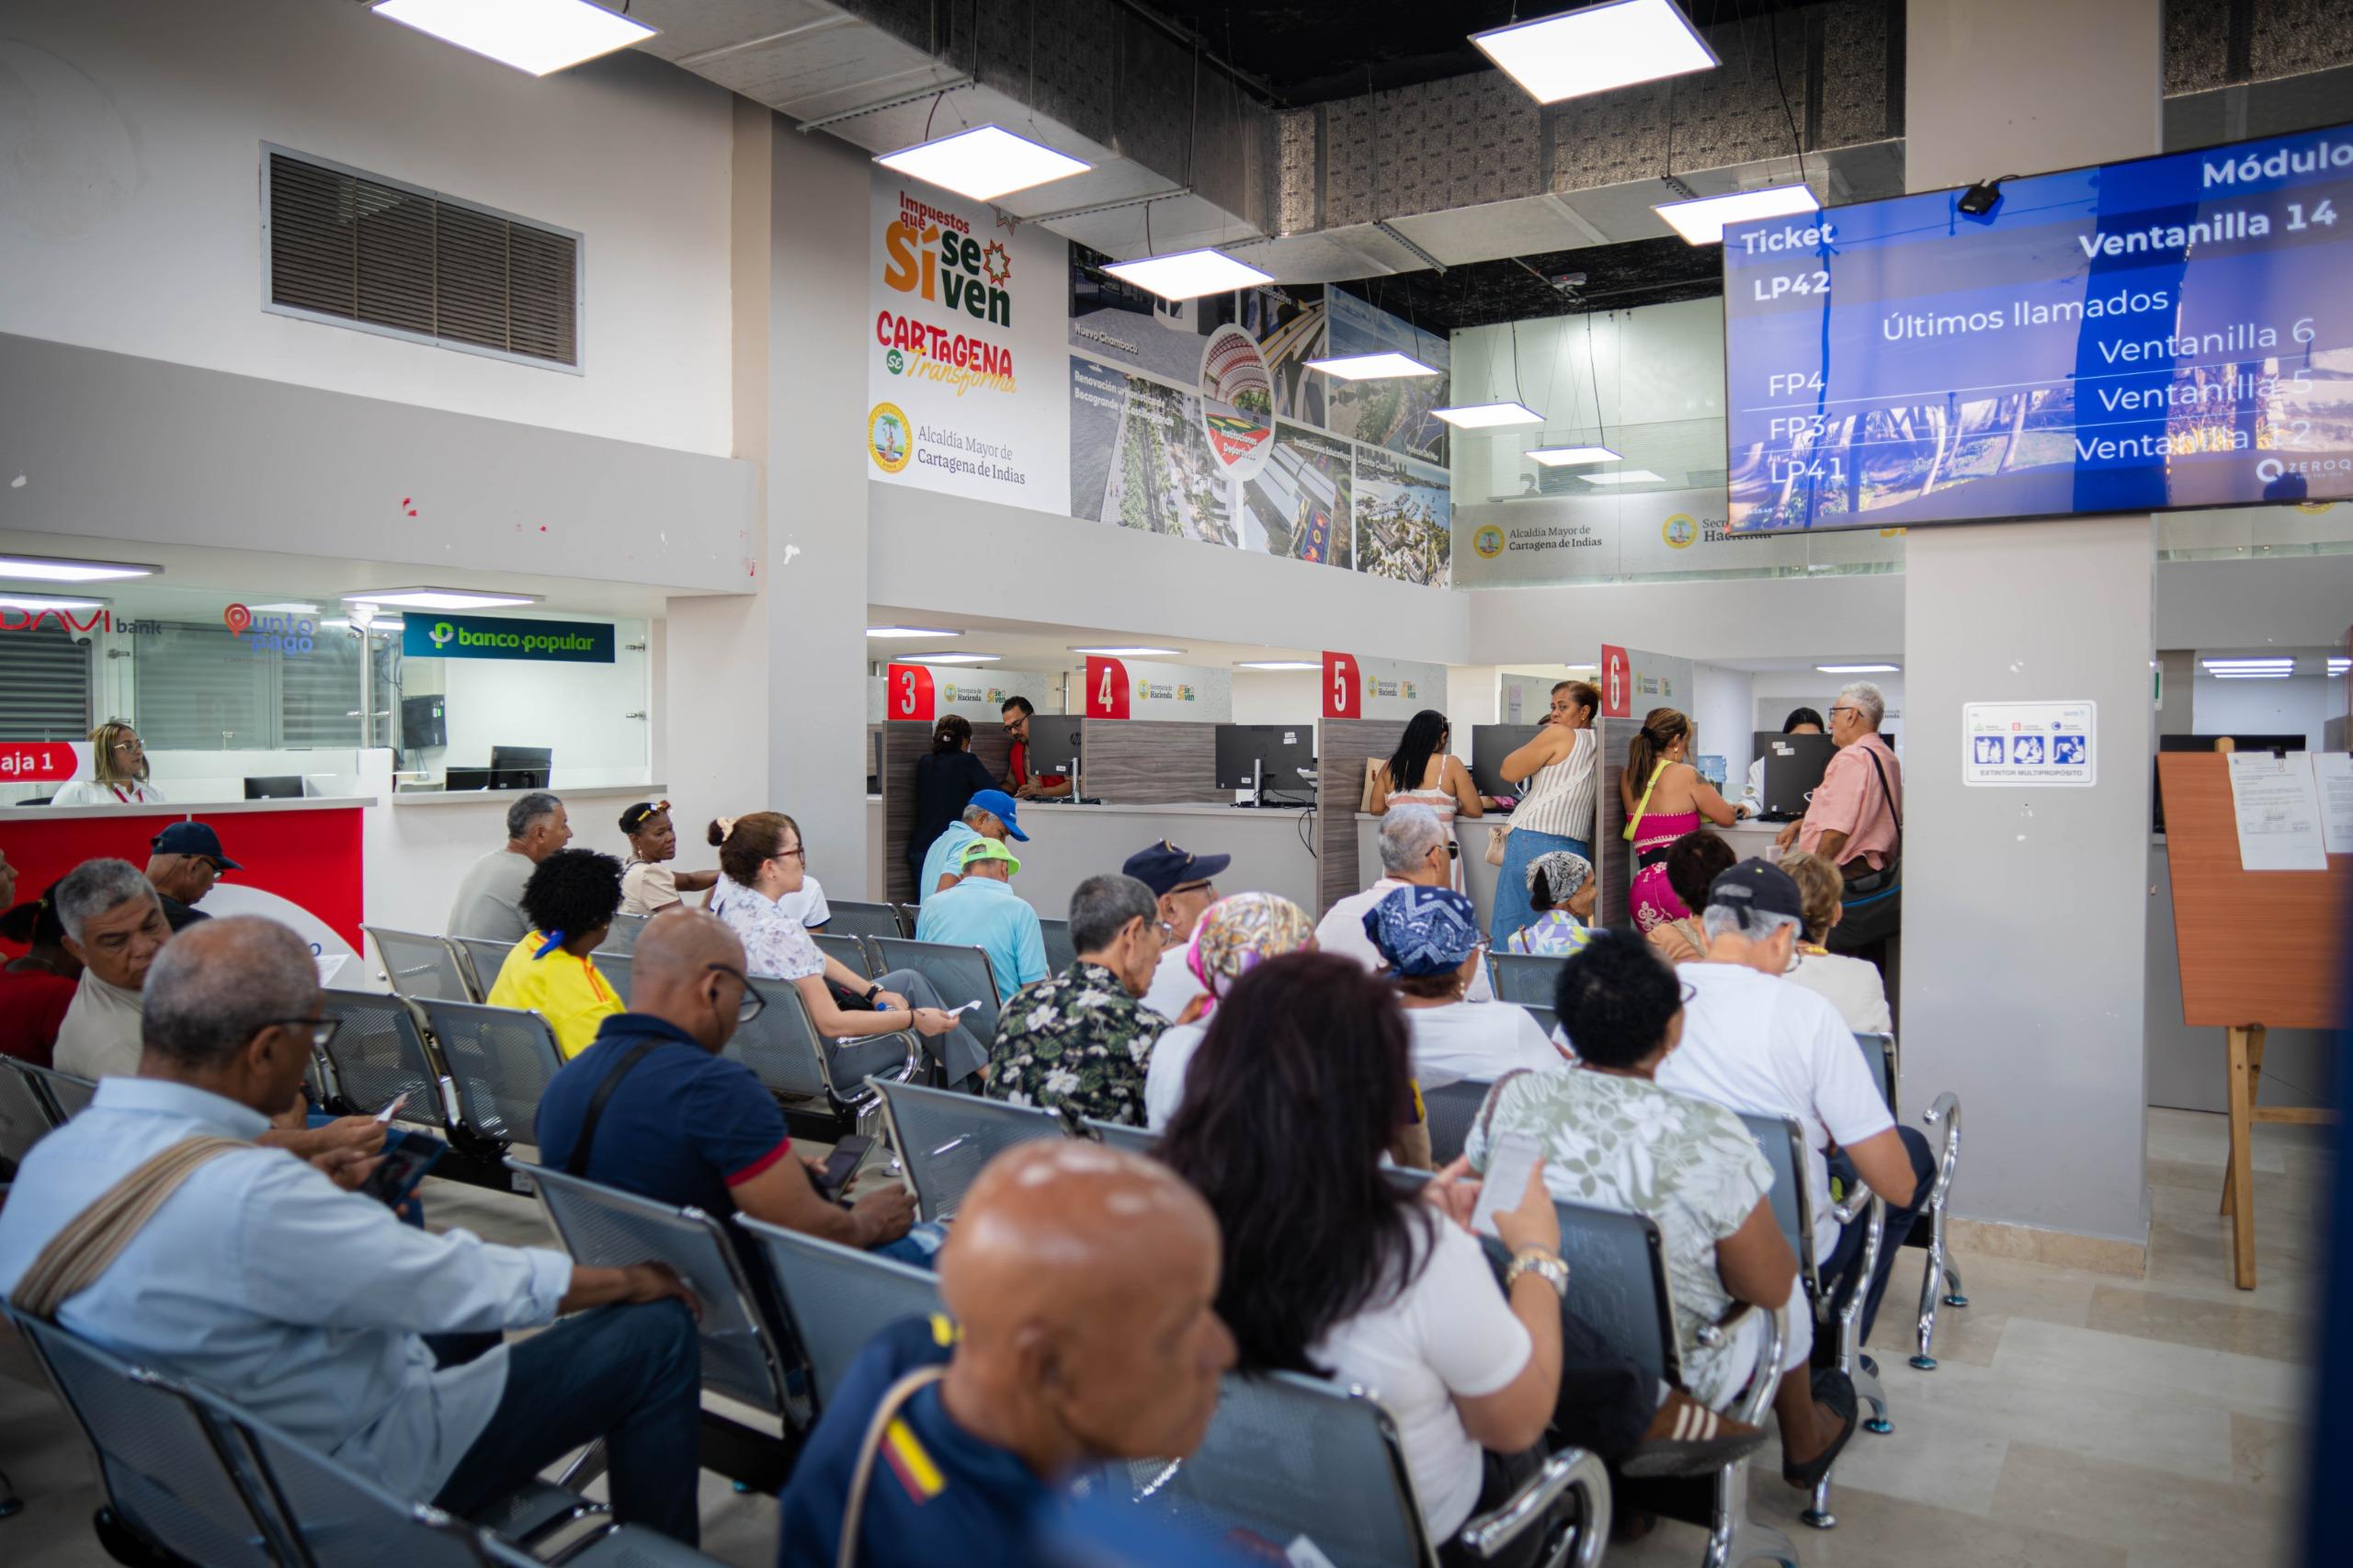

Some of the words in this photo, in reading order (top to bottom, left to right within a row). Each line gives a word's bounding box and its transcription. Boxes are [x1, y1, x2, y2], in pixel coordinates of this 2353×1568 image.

[2202, 142, 2353, 187] Módulo
[900, 190, 970, 234] Impuestos
[900, 210, 926, 231] que
[2078, 210, 2270, 259] Ventanilla
[2286, 199, 2337, 232] 14
[940, 230, 982, 277] se
[1741, 222, 1835, 255] Ticket
[940, 267, 1010, 328] ven
[1754, 270, 1831, 301] LP42
[1074, 323, 1098, 340] Nuevo
[1883, 311, 2005, 341] Últimos
[2014, 289, 2169, 326] llamados
[876, 310, 1013, 380] CARTAGENA
[2097, 322, 2278, 364] Ventanilla
[2292, 317, 2316, 344] 6
[906, 345, 1017, 398] Transforma
[1074, 369, 1117, 395] Renovación
[1769, 370, 1826, 398] FP4
[1074, 387, 1119, 411] Bocagrande
[2097, 371, 2279, 412] Ventanilla
[2292, 368, 2313, 394] 5
[918, 426, 963, 449] Alcaldía
[965, 436, 999, 460] Mayor
[1000, 445, 1013, 460] de
[1770, 415, 1825, 440] FP3
[2075, 420, 2250, 461] Ventanilla
[917, 449, 976, 473] Cartagena
[977, 461, 992, 477] de
[993, 464, 1026, 484] Indias
[1772, 458, 1845, 483] LP41
[2289, 460, 2351, 472] ZEROQ
[1508, 540, 1557, 551] Cartagena
[1559, 539, 1571, 548] de
[1572, 537, 1602, 547] Indias
[1548, 527, 1577, 537] Mayor
[1579, 525, 1591, 535] de
[116, 618, 162, 636] bank
[252, 632, 313, 655] pago
[459, 627, 519, 647] banco
[522, 632, 596, 653] popular
[902, 671, 916, 715] 3
[1098, 666, 1113, 712] 4
[1335, 661, 1347, 712] 5
[1610, 653, 1620, 710] 6
[1, 752, 34, 775] aja
[42, 753, 53, 770] 1
